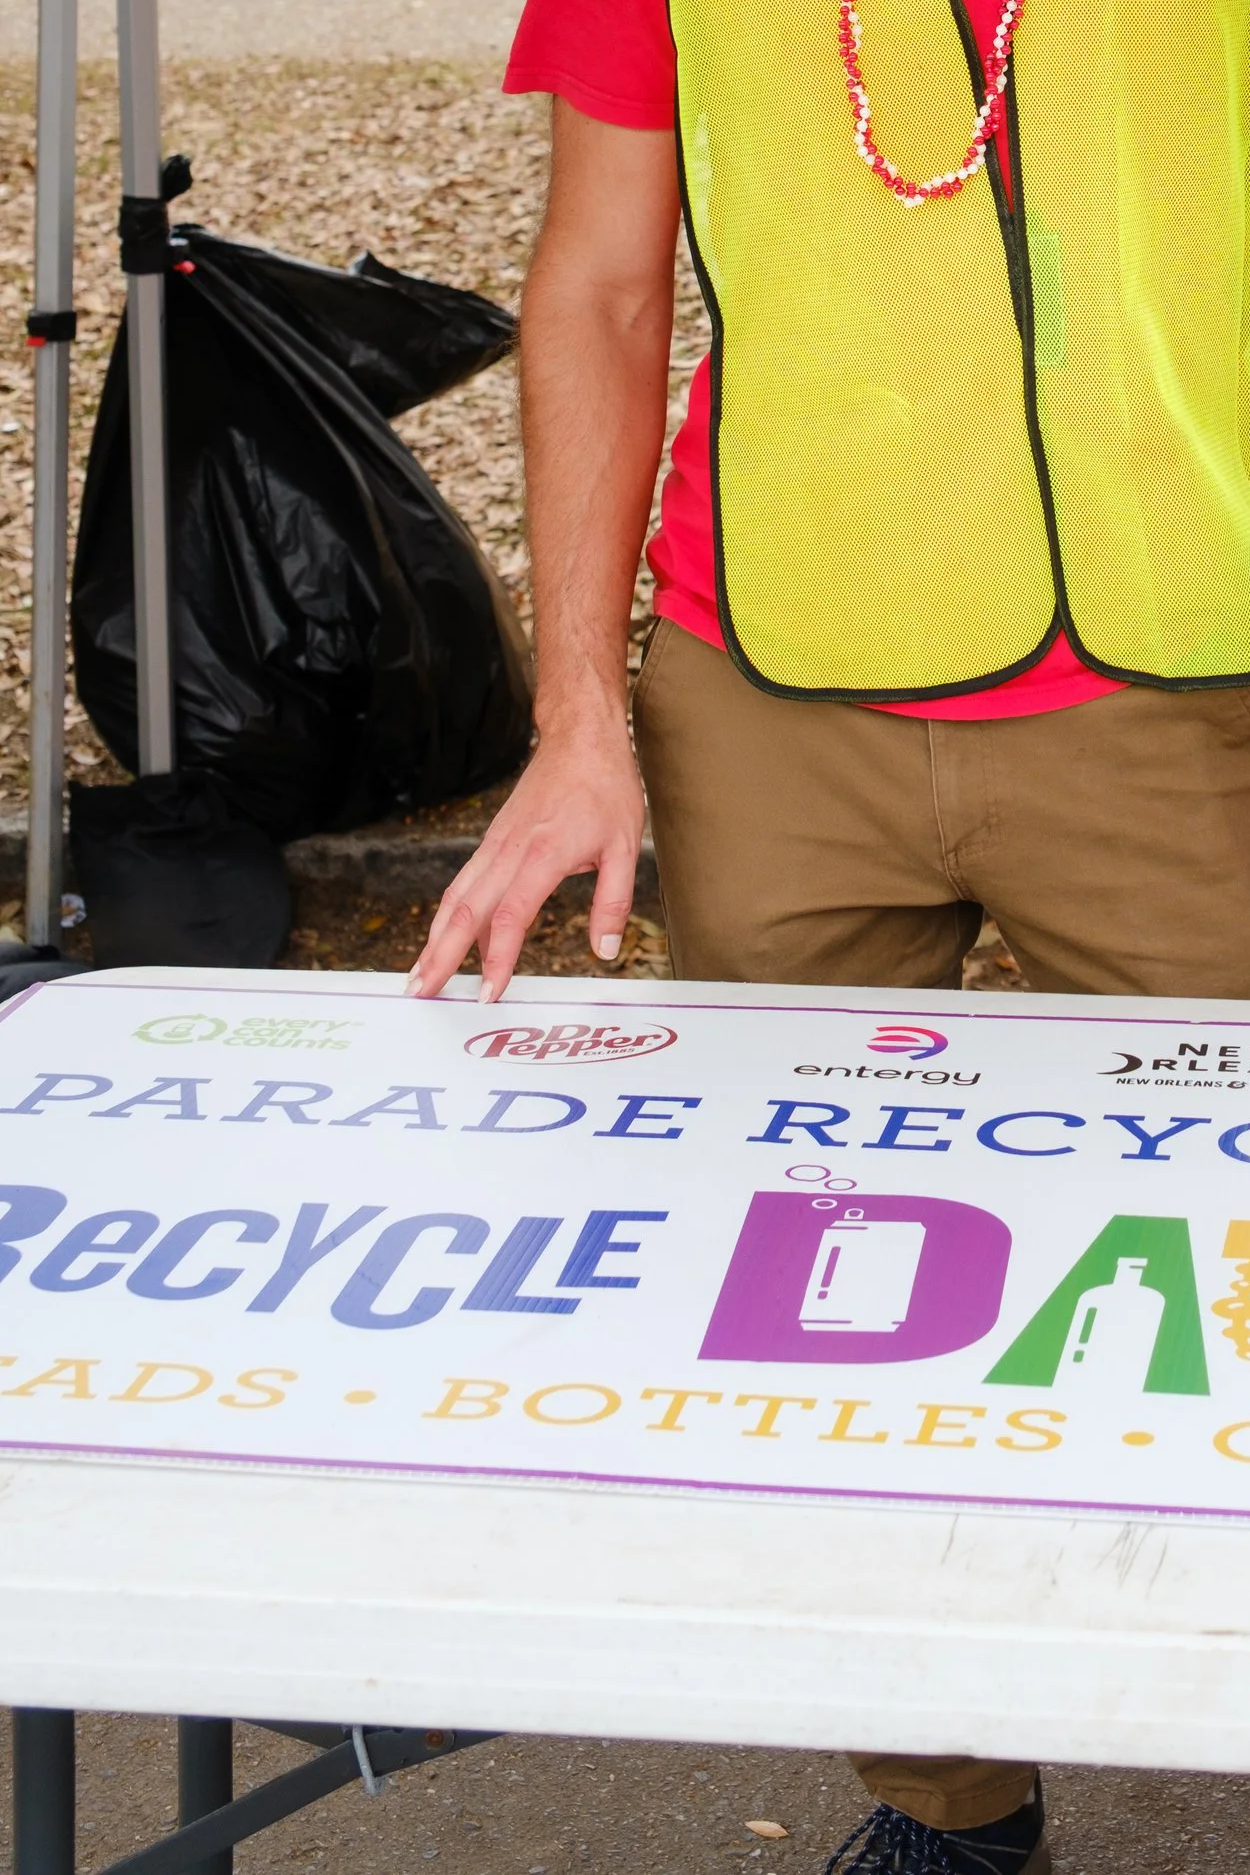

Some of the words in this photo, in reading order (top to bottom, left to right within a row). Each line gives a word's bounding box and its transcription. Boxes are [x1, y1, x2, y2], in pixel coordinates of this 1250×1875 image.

[232, 1027, 303, 1038] can
[241, 1017, 351, 1032] every
[544, 1024, 621, 1043] Dr
[222, 1036, 352, 1050] counts
[479, 1027, 662, 1060] Pepper
[793, 1064, 981, 1086] entergy
[1116, 1077, 1150, 1086] NEW
[1154, 1078, 1223, 1088] ORLEANS
[0, 1073, 703, 1140] PARADE
[421, 1378, 1068, 1452] BOTTLES
